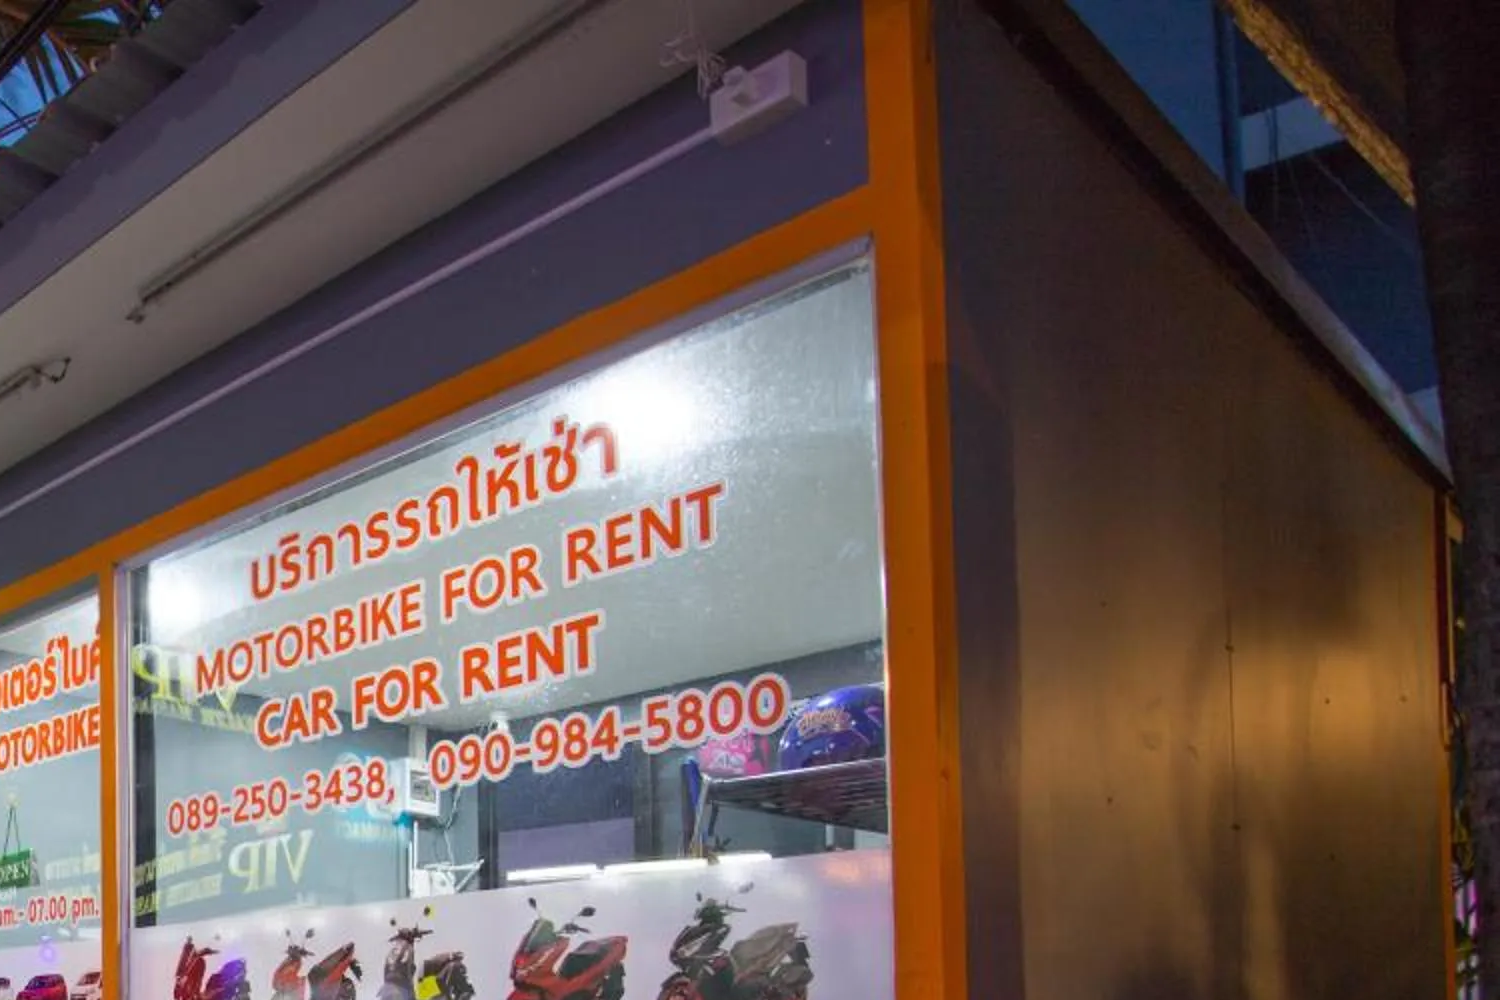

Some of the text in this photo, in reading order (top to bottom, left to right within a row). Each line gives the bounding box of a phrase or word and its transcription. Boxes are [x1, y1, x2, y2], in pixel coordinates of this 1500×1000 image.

[250, 417, 617, 599] บริการรถให้เช่า
[196, 482, 724, 694] MOTORBIKE FOR RENT
[168, 678, 787, 835] 089-250-3438, 090-984-5800
[256, 688, 337, 748] CAR
[354, 668, 440, 728] FOR
[462, 615, 601, 696] RENT
[28, 895, 67, 923] 07.00
[71, 897, 100, 925] pm.
